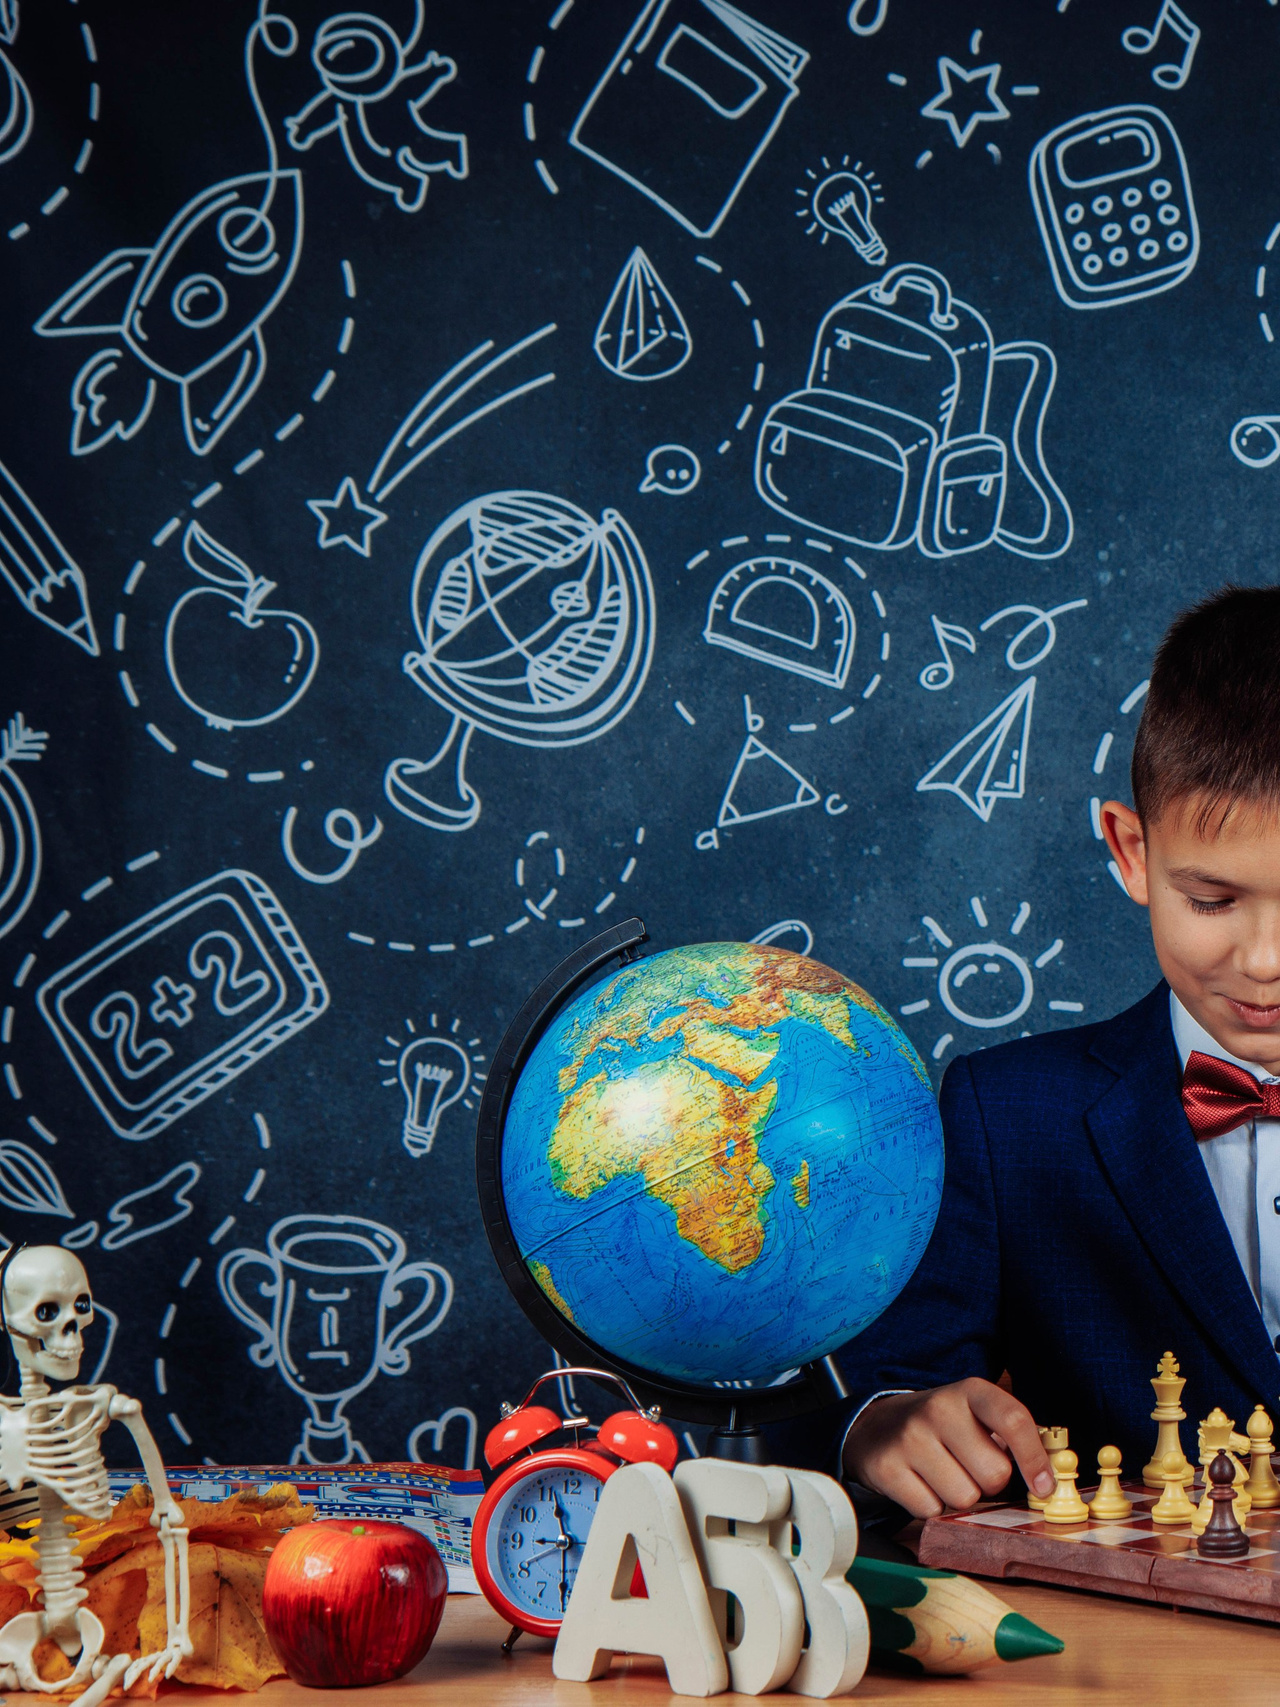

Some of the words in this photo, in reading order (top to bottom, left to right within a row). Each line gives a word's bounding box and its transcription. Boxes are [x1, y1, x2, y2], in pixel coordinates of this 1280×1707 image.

[743, 694, 764, 732] b
[825, 793, 848, 815] c
[696, 828, 719, 850] a
[90, 930, 271, 1080] 2+2
[197, 1470, 379, 1478] ПРЕДМЕТЫ
[389, 1473, 450, 1486] ВСЕ
[288, 1475, 453, 1493] ТИПОВЫЕ
[563, 1479, 582, 1495] 12
[539, 1486, 554, 1501] 11
[520, 1507, 537, 1523] 10
[511, 1532, 524, 1550] 9
[517, 1561, 531, 1579] 8
[536, 1581, 547, 1598] 7
